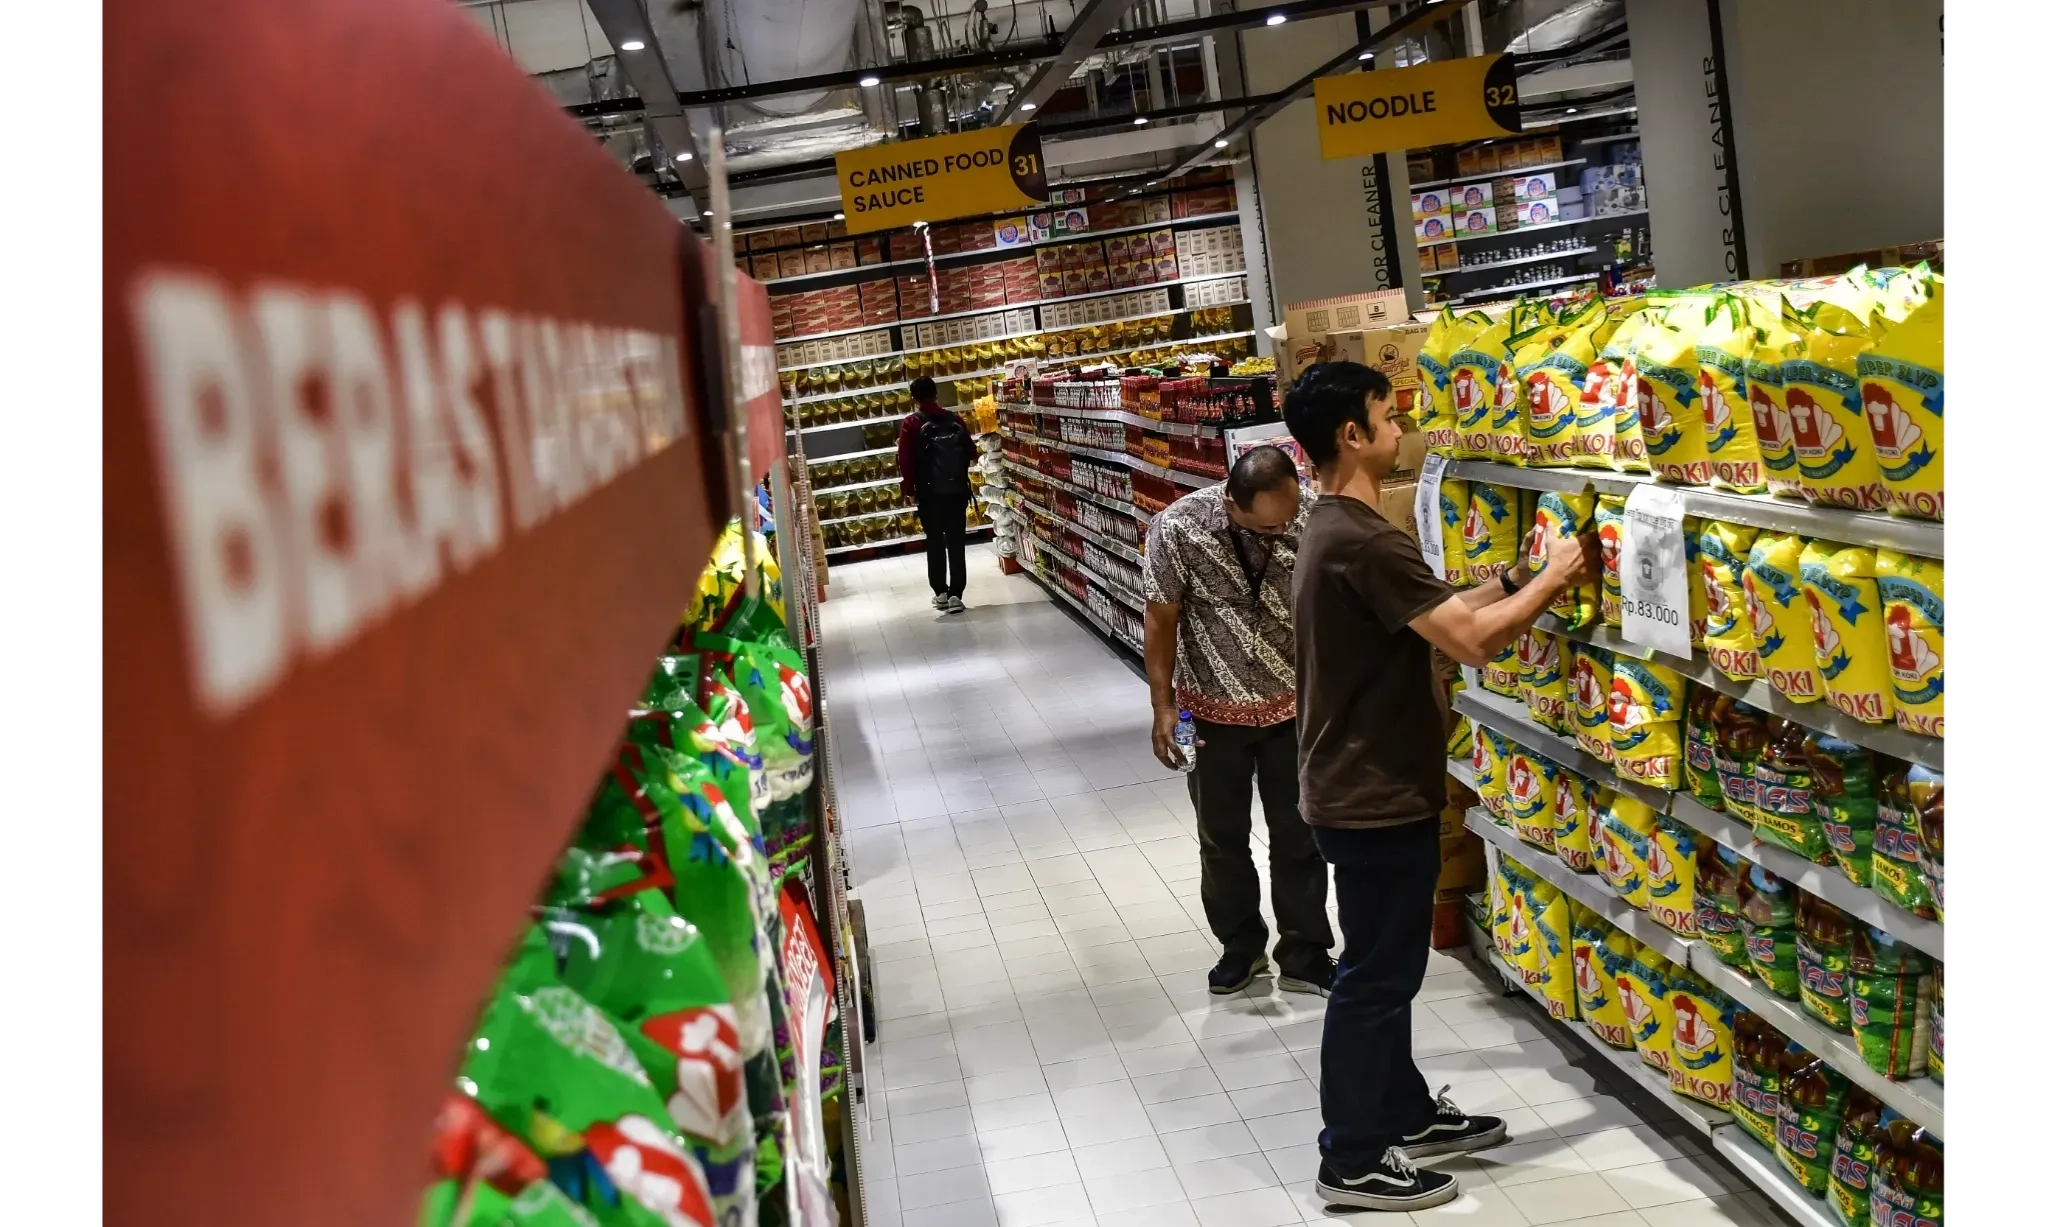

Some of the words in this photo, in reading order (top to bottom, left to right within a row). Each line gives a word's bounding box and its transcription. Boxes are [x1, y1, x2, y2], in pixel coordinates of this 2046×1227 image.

[1328, 90, 1437, 125] NOODLE
[1486, 85, 1516, 108] 32
[1702, 55, 1730, 217] CLEANER
[849, 158, 940, 189] CANNED
[943, 148, 1005, 173] FOOD
[1015, 153, 1039, 177] 31
[853, 185, 926, 214] SAUCE
[1361, 165, 1385, 252] CLEANER
[130, 264, 502, 722] BERAS
[1622, 596, 1678, 626] Rp.83.000
[1689, 1076, 1731, 1104] KOK
[1874, 1178, 1915, 1211] UMAH
